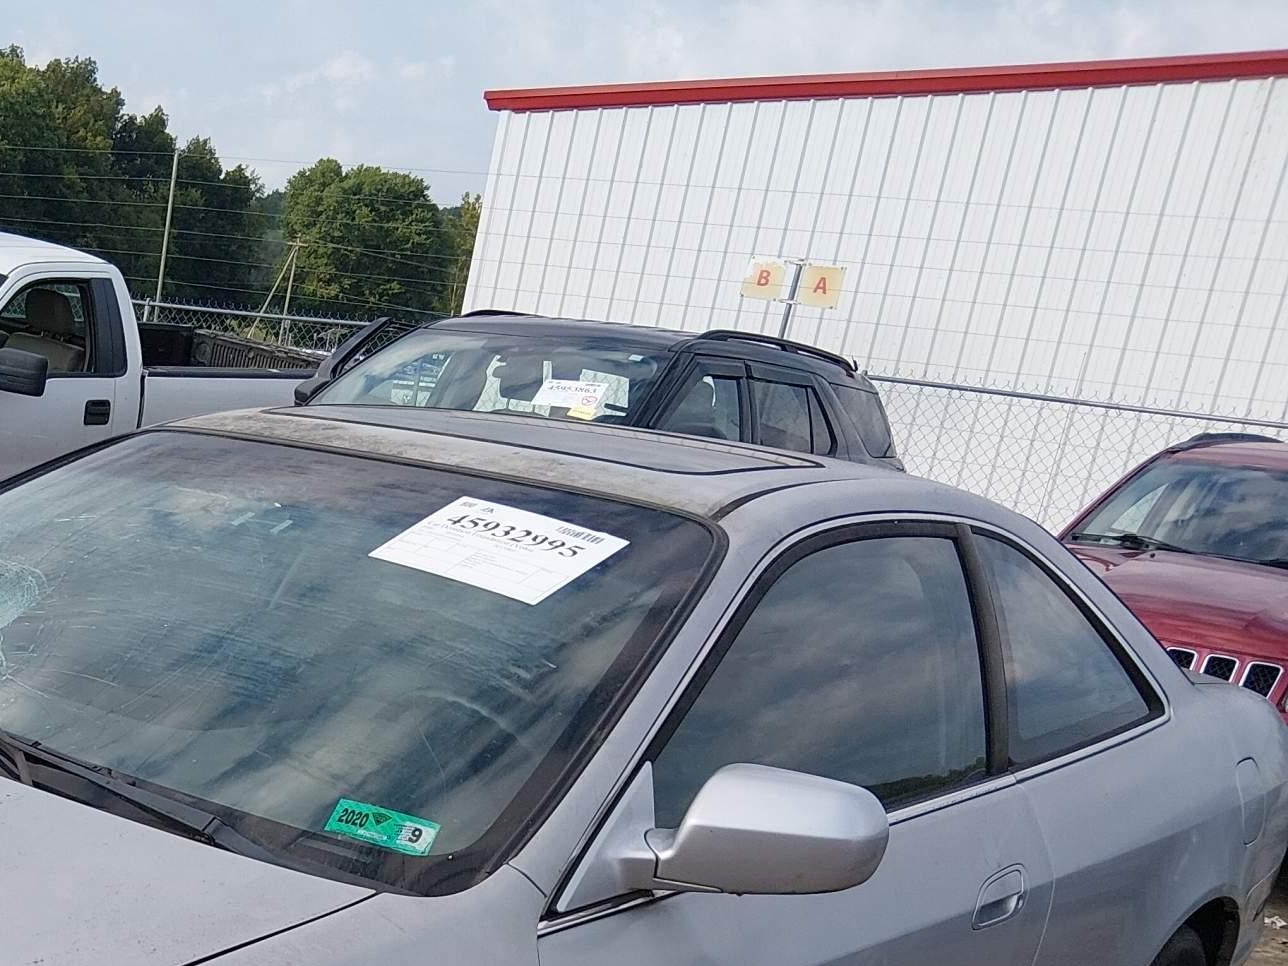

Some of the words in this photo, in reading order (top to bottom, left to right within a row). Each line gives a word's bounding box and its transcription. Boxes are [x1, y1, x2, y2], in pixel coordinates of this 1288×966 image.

[756, 269, 771, 287] B
[813, 276, 827, 295] A
[447, 514, 587, 558] 45932995
[337, 807, 370, 828] 2020
[407, 826, 423, 843] 9
